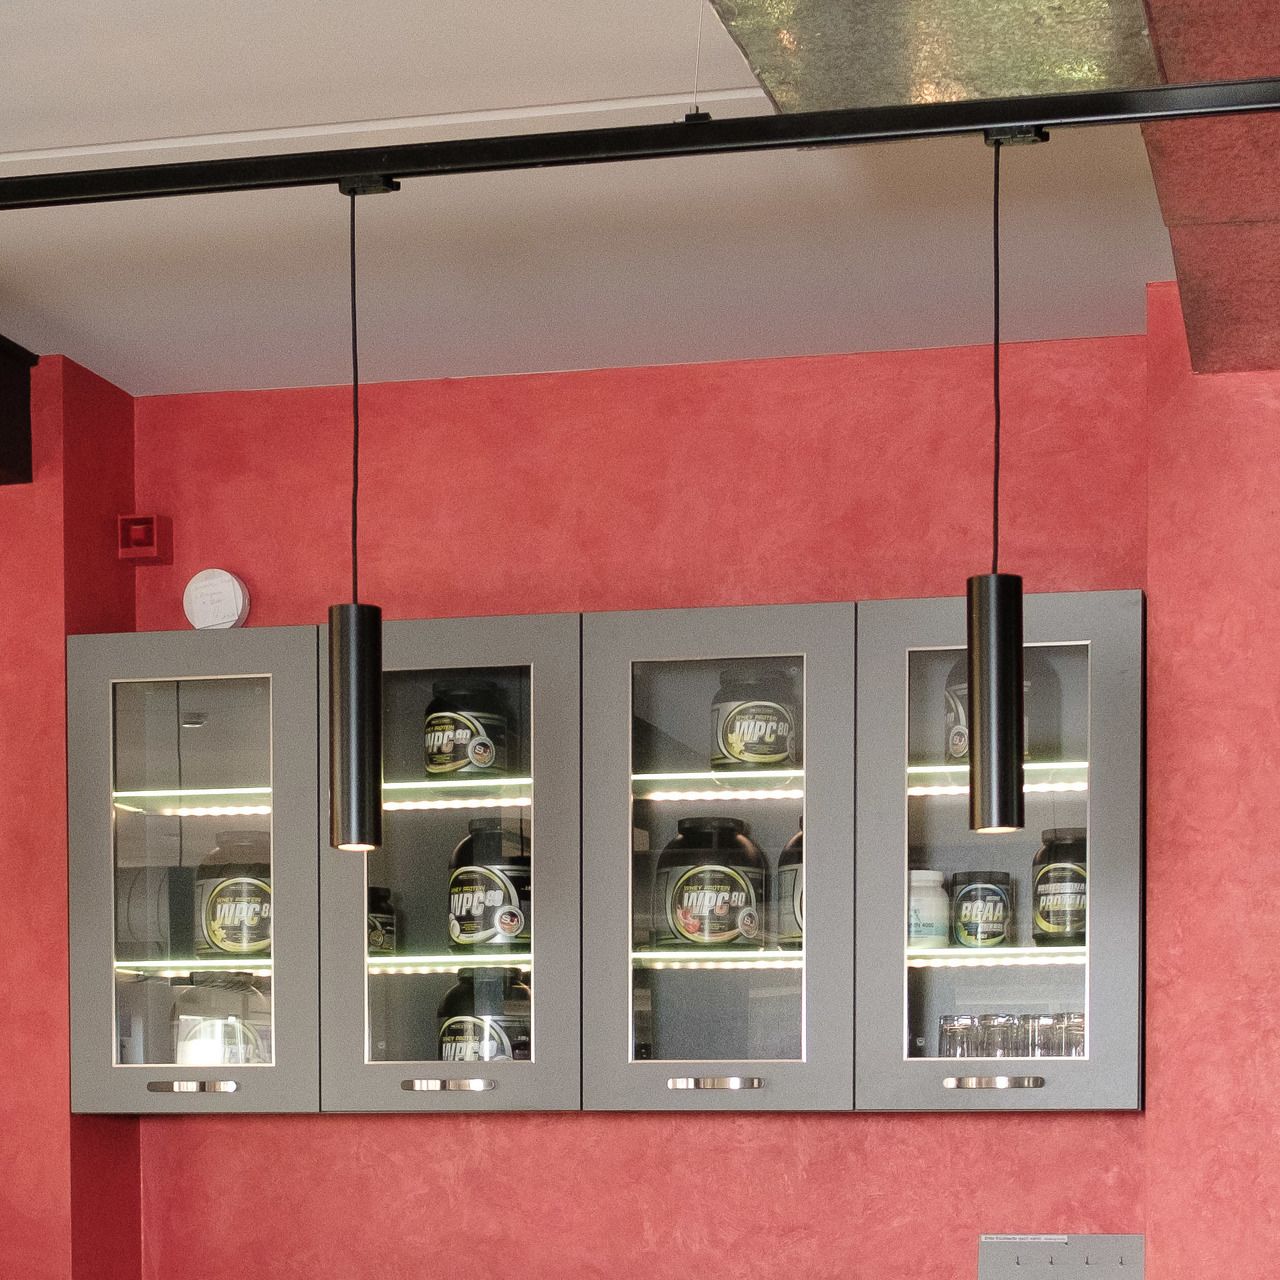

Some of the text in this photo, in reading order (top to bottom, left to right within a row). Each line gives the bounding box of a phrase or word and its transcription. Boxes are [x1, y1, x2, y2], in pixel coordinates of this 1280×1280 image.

[735, 720, 789, 743] WPC 80
[216, 902, 260, 926] WPC
[451, 891, 484, 917] WPC
[683, 891, 746, 916] WPC 80
[961, 900, 1004, 921] BCAA
